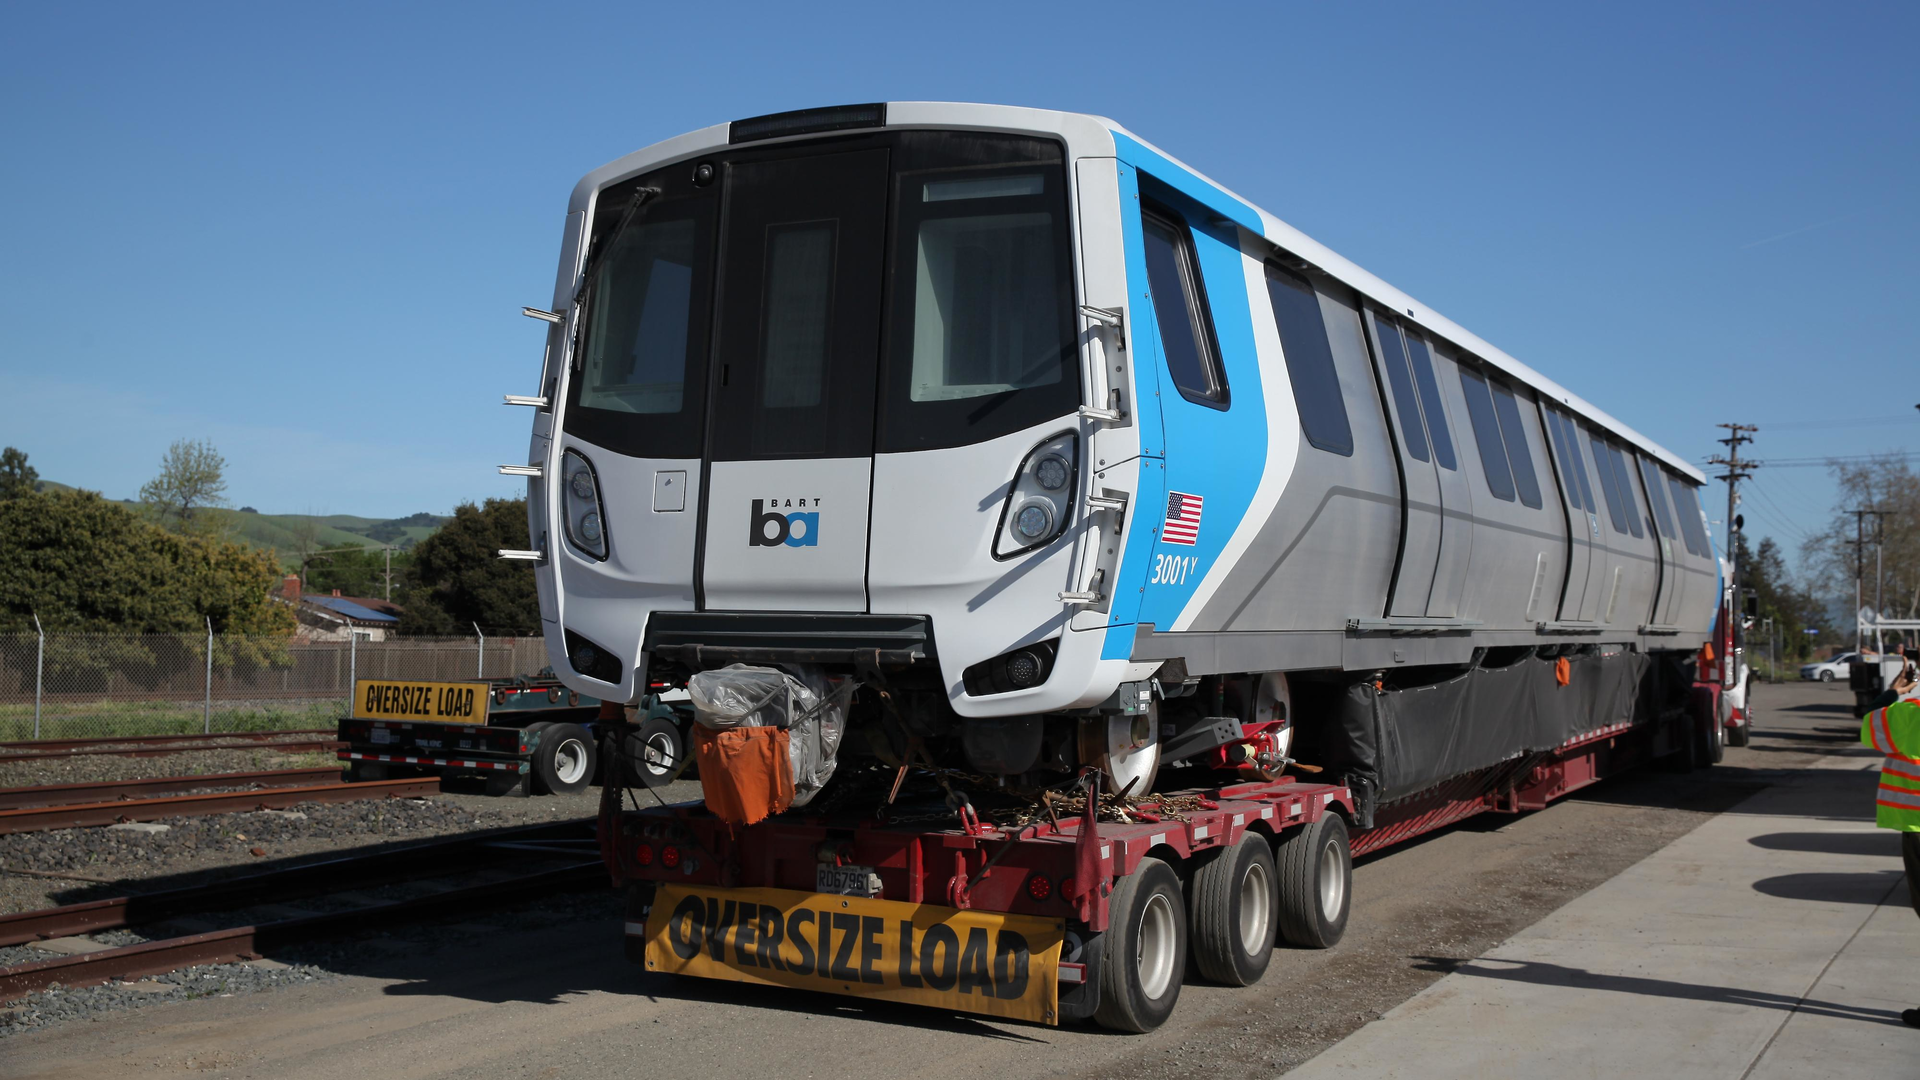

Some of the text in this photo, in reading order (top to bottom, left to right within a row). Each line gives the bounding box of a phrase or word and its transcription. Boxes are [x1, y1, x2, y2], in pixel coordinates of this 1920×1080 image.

[770, 498, 821, 508] BART
[366, 684, 474, 717] OVERSIZE LOAD
[818, 869, 868, 891] RD6796
[669, 894, 1030, 1000] OVERSIZE LOAD
